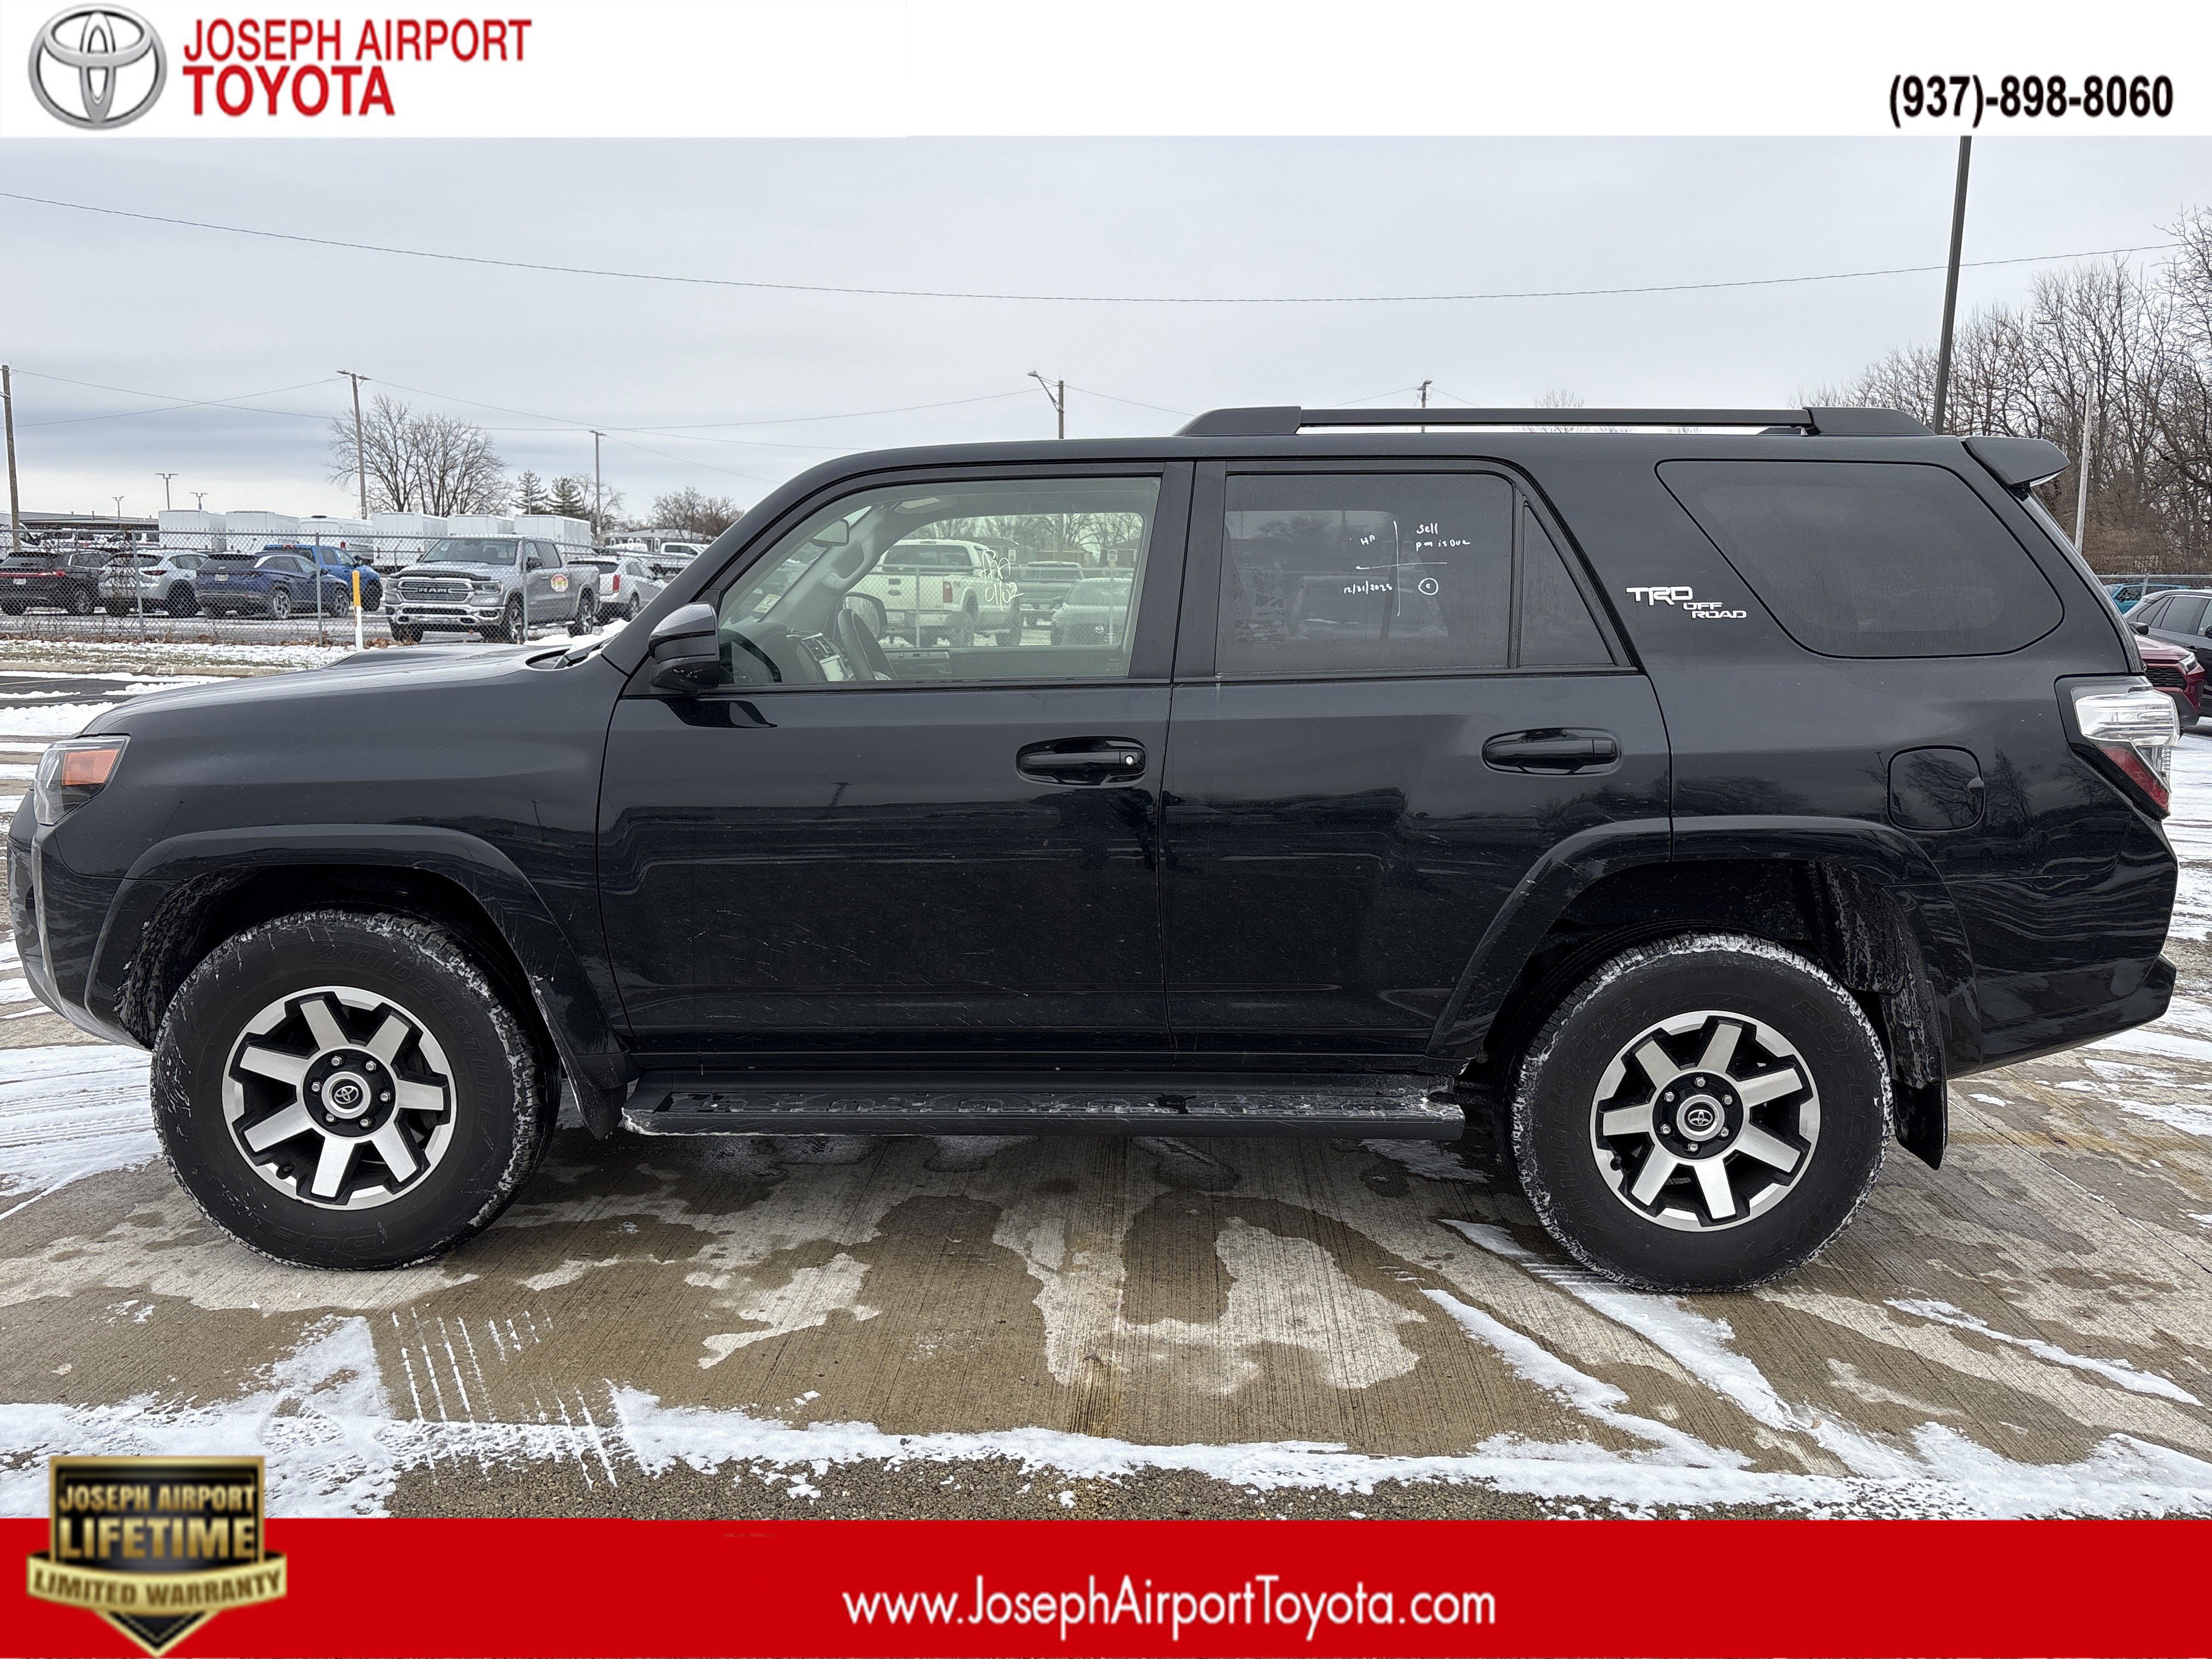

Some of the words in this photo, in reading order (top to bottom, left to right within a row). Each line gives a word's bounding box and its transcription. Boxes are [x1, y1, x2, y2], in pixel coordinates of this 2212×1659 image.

[1626, 586, 1694, 606] TRD
[1683, 602, 1723, 610] OFF
[1691, 610, 1747, 619] ROAD
[314, 945, 495, 1130] BRIDGESTONE
